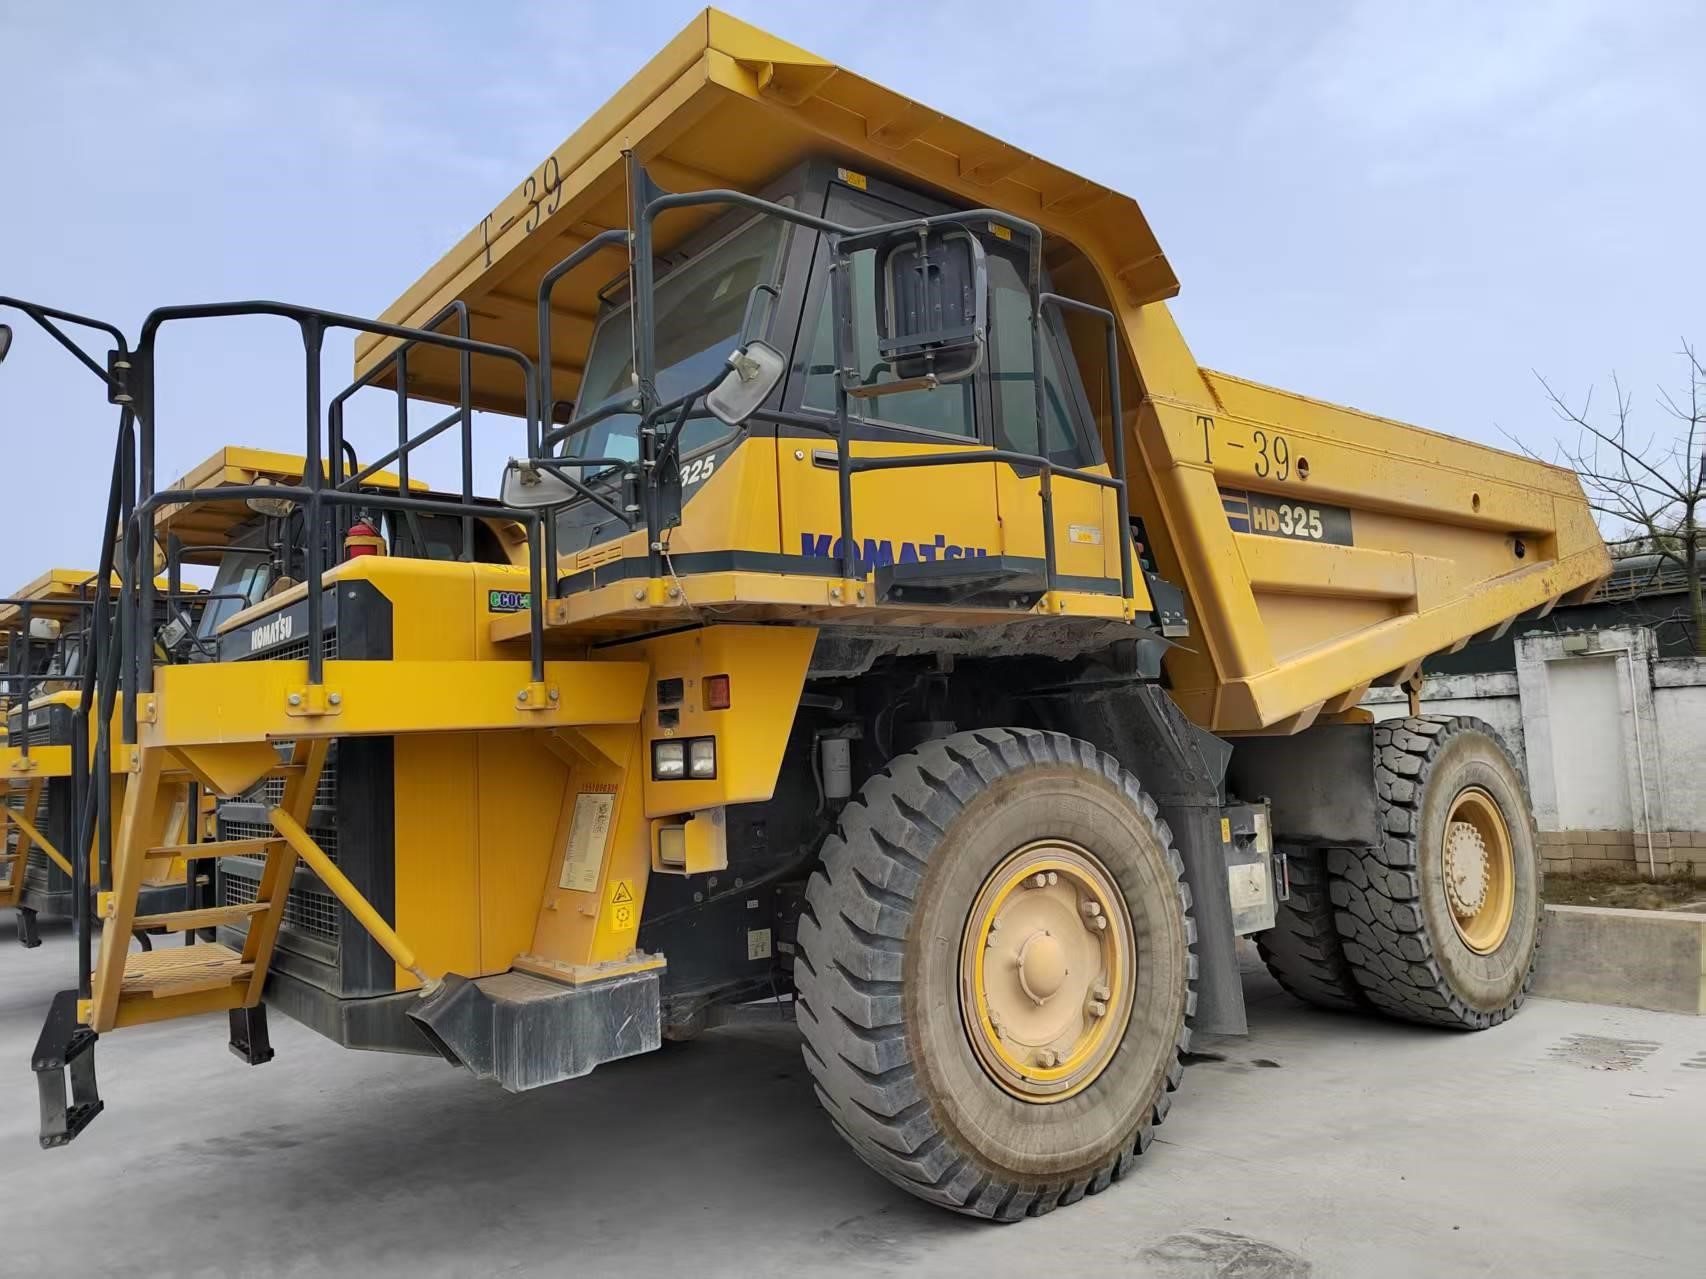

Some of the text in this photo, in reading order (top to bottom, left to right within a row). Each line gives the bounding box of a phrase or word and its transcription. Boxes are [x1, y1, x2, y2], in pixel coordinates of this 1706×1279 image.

[680, 454, 716, 488] 325
[1252, 504, 1323, 539] HD325
[251, 612, 292, 651] KOMATSU
